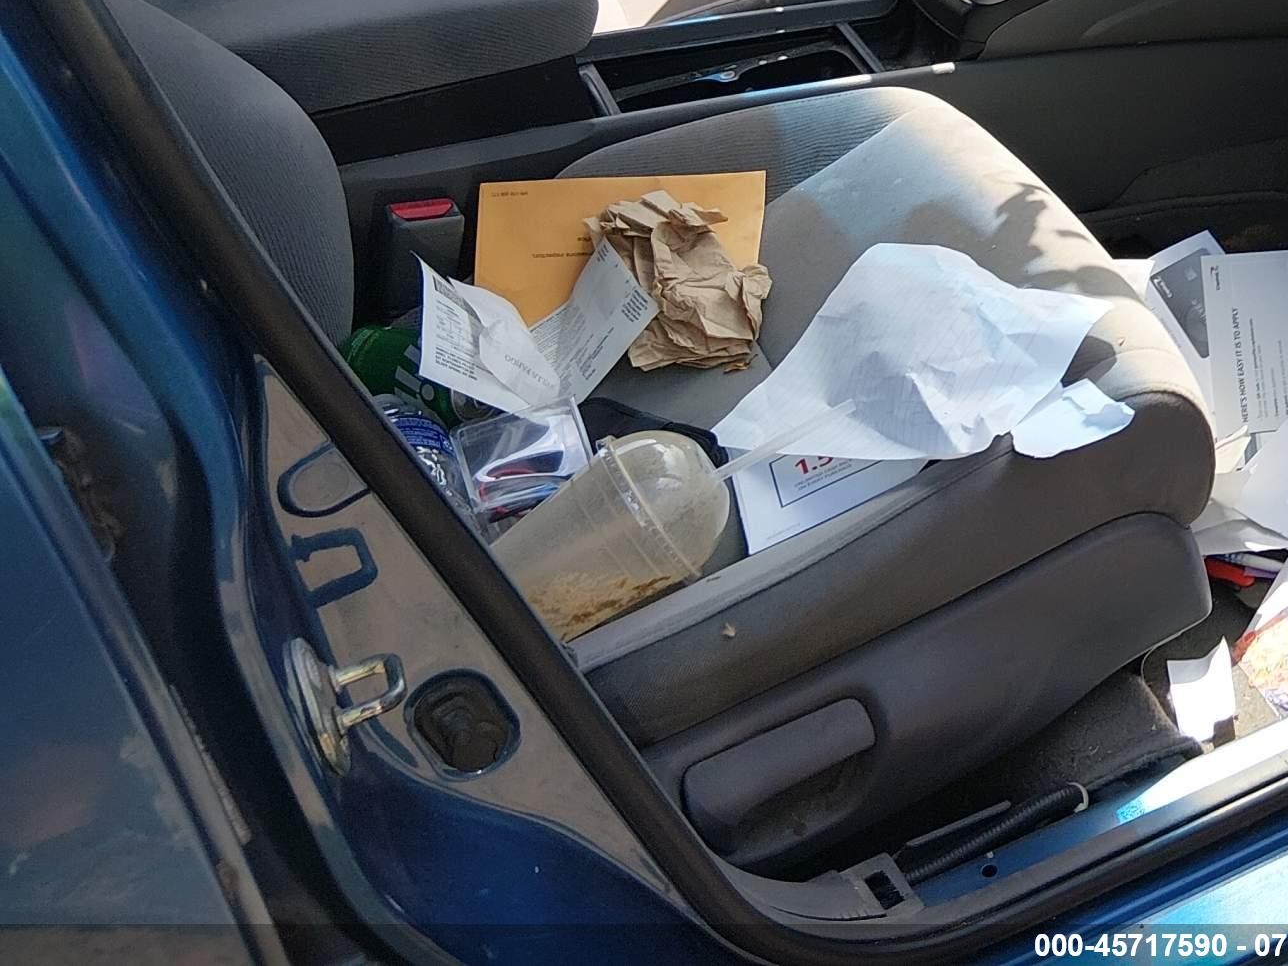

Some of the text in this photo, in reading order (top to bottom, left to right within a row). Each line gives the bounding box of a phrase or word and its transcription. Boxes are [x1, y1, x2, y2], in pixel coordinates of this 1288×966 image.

[1231, 307, 1240, 329] APPLY
[1236, 358, 1245, 376] EASY
[1238, 378, 1246, 395] HOW
[1240, 397, 1249, 423] HERE'S
